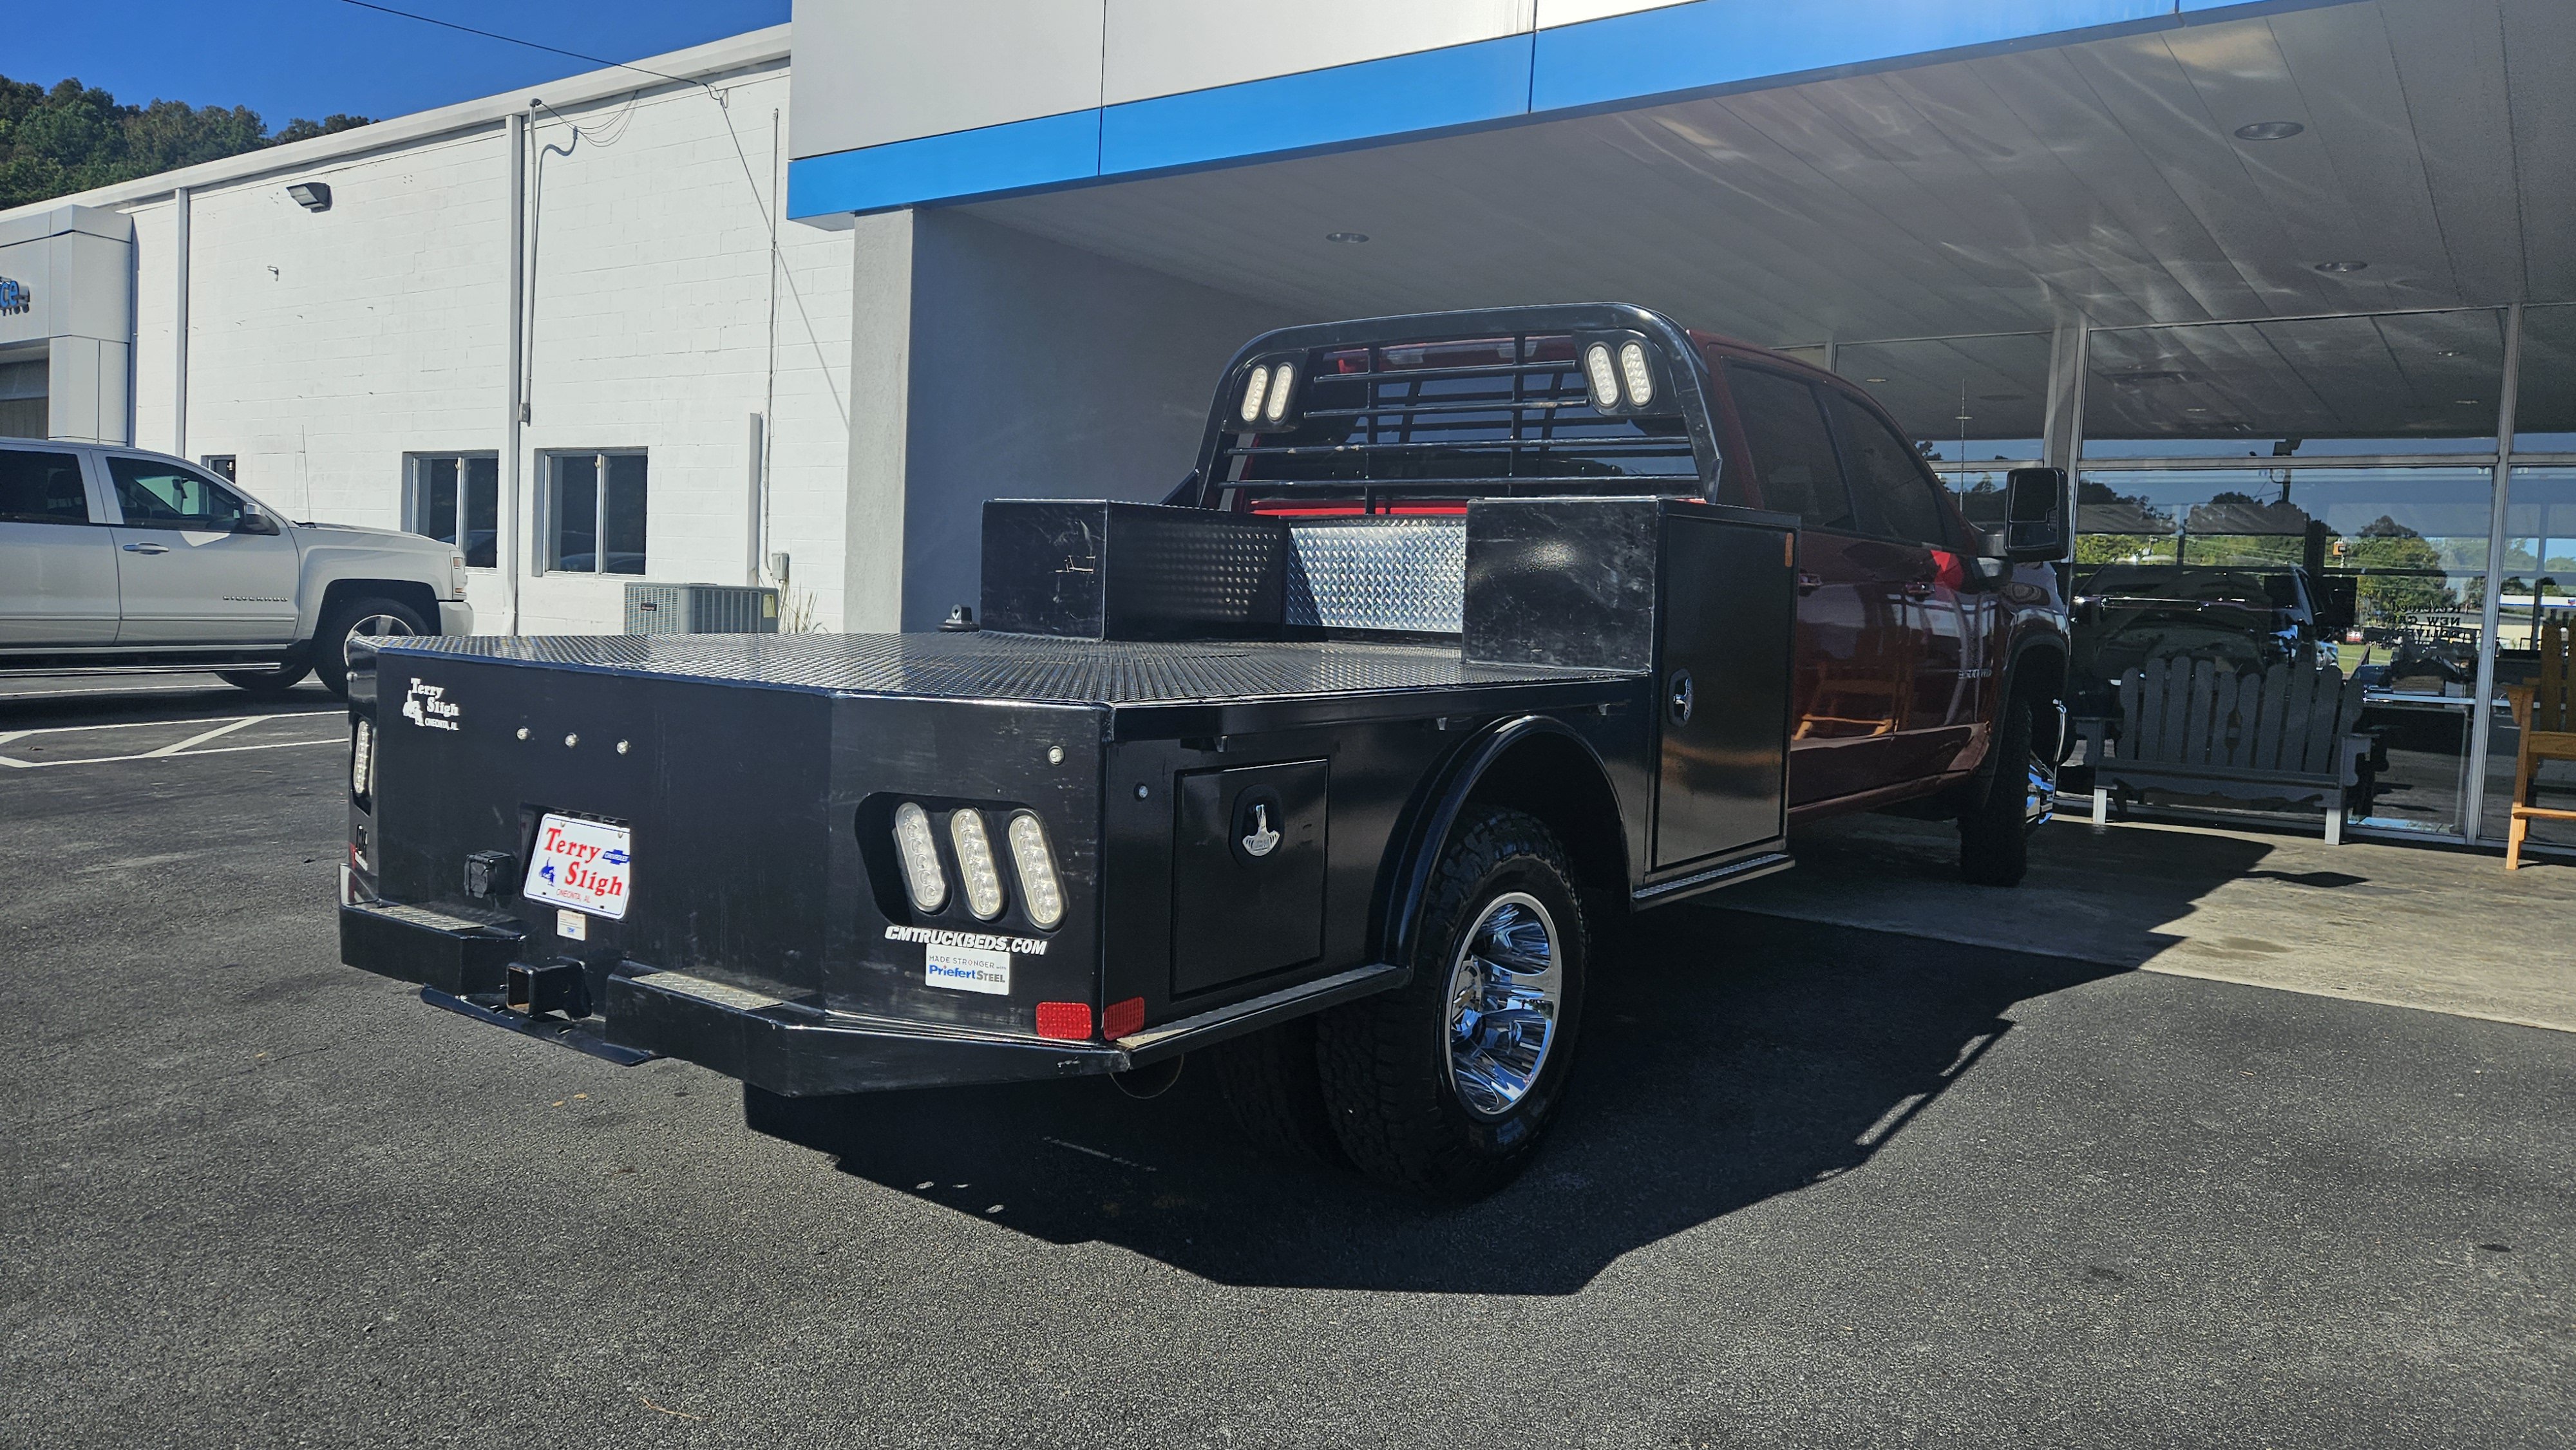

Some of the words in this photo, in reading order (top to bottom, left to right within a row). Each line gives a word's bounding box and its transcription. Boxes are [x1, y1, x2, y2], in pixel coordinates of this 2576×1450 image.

[410, 677, 445, 699] Terry
[426, 696, 460, 717] Sligh
[544, 827, 601, 864] Terry
[565, 861, 623, 897] Sligh
[884, 925, 1048, 956] CMTRUCKBEDS.COM
[929, 955, 951, 963] MADE
[952, 957, 994, 969] STRONGER
